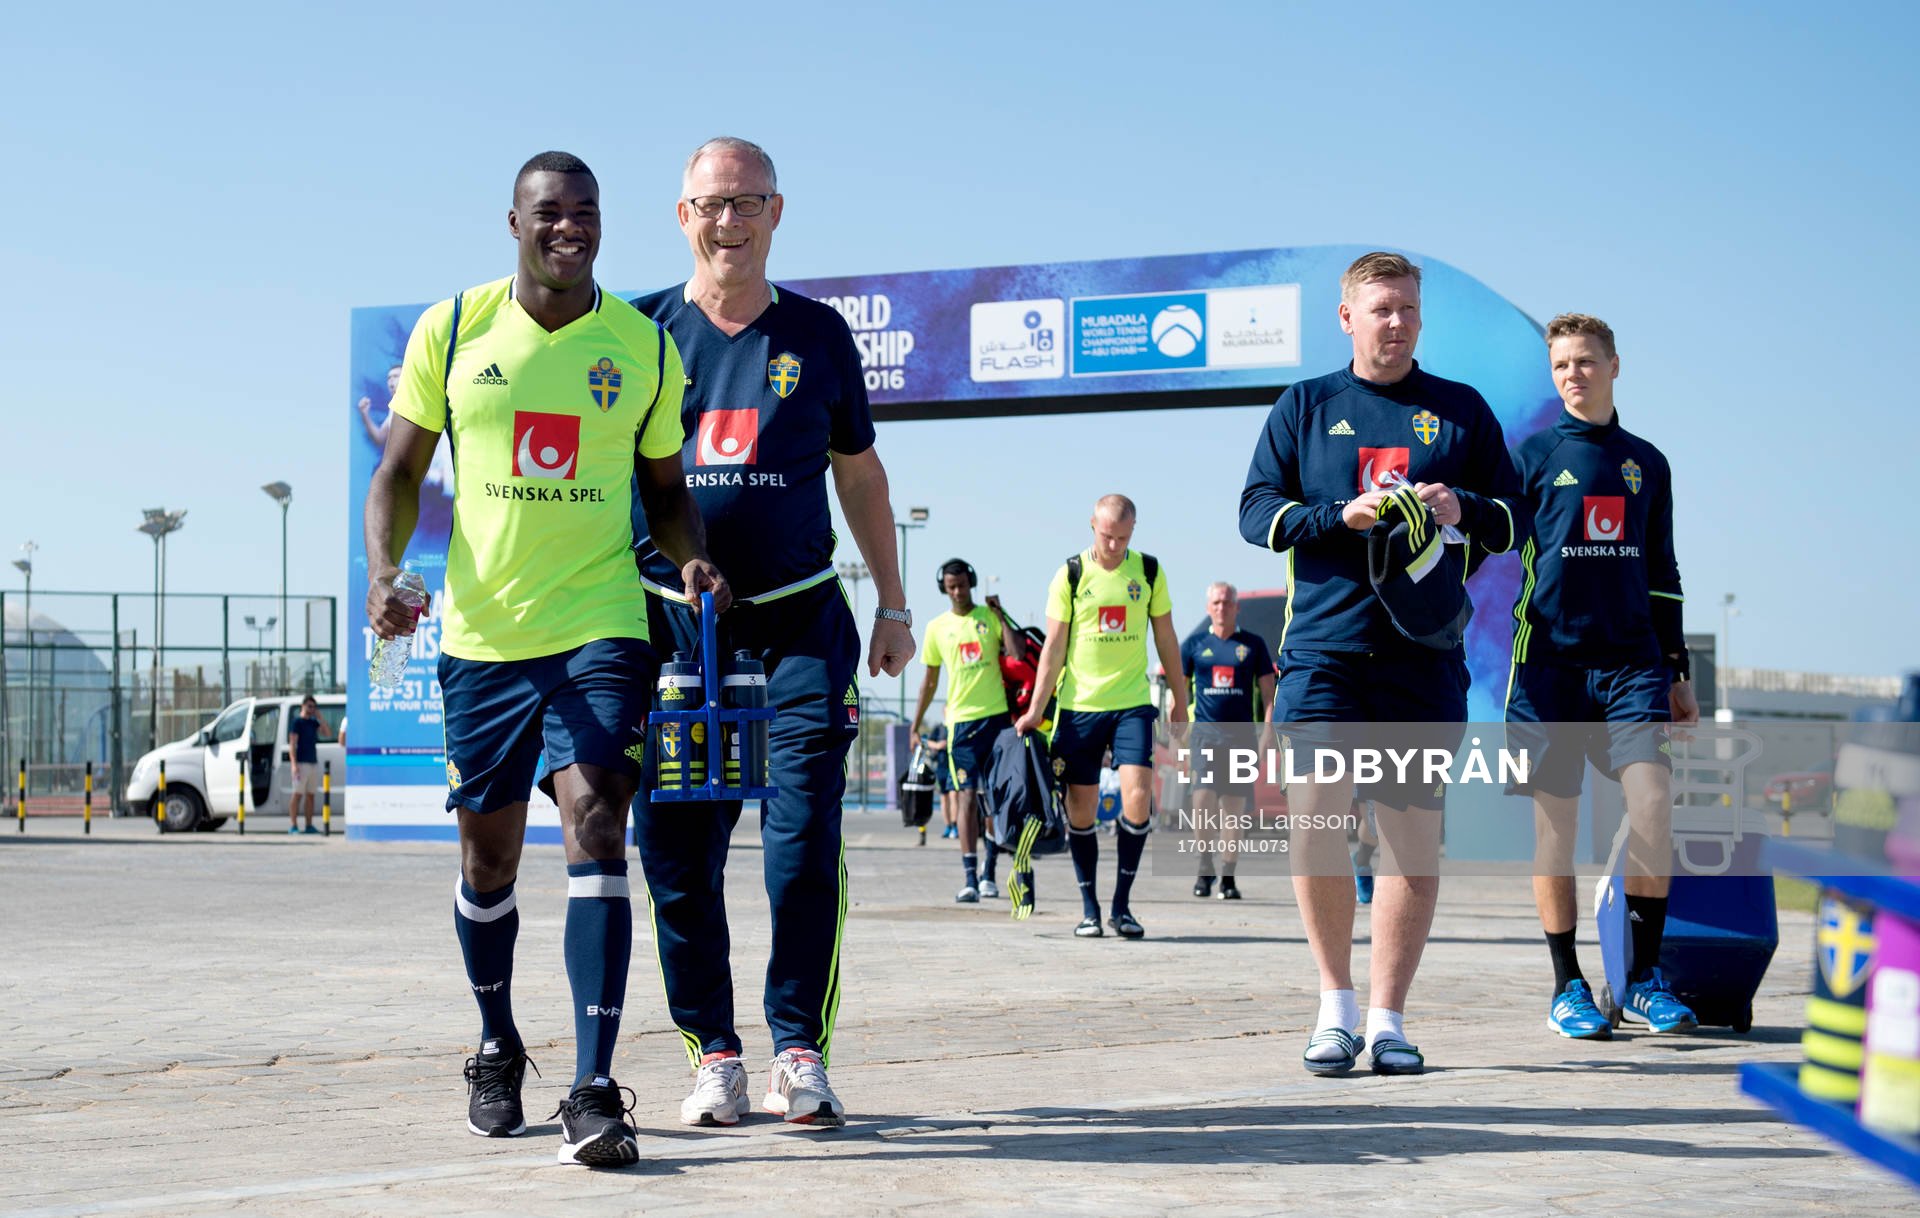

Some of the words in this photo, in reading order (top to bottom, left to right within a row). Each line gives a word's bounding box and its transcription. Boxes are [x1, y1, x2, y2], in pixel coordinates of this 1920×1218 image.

[813, 294, 891, 331] RLD
[1081, 314, 1148, 328] MUBADALA
[852, 330, 914, 368] SHIP
[980, 355, 1055, 371] FLASH
[472, 376, 508, 386] adidas
[863, 369, 905, 391] 016
[685, 473, 744, 488] ENSKA
[748, 473, 787, 487] SPEL
[1553, 478, 1579, 487] adidas
[485, 482, 563, 502] SVENSKA
[569, 488, 605, 502] SPEL
[1561, 546, 1616, 558] SVENSKA
[1619, 546, 1640, 557] SPEL
[668, 676, 675, 687] 6
[748, 675, 756, 685] 3
[661, 692, 685, 701] adidas
[369, 701, 391, 711] BUY
[393, 701, 421, 711] YOUR
[484, 1041, 497, 1049] NIKE
[593, 1076, 609, 1085] NIKE
